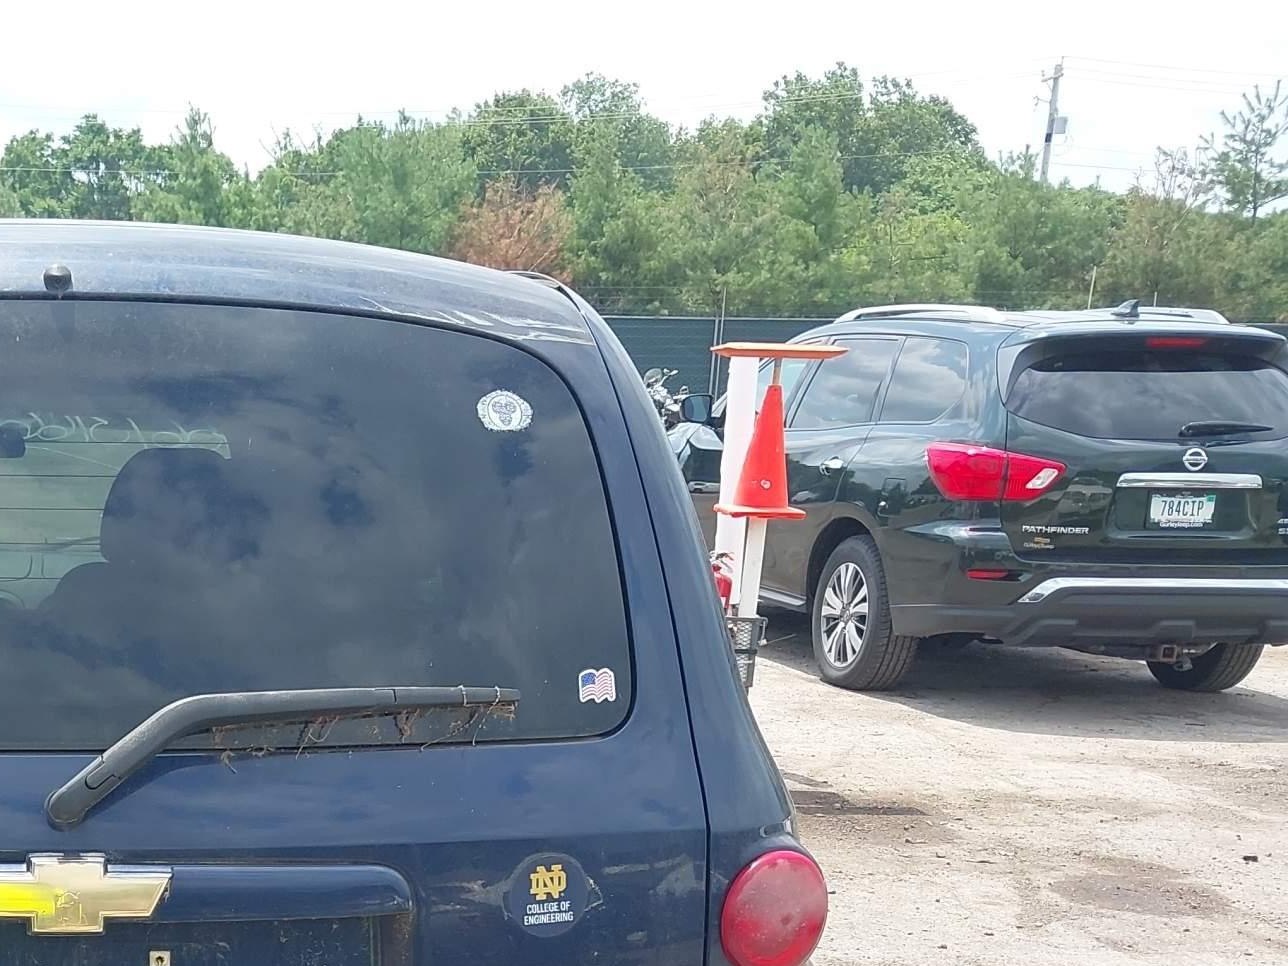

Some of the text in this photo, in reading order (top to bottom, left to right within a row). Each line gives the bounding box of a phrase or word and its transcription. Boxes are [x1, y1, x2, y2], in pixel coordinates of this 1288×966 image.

[1160, 500, 1205, 517] 784CIP
[1022, 525, 1090, 535] PATHFINDER
[526, 901, 571, 914] COLLEGE OF
[523, 911, 574, 926] ENGINEERING
